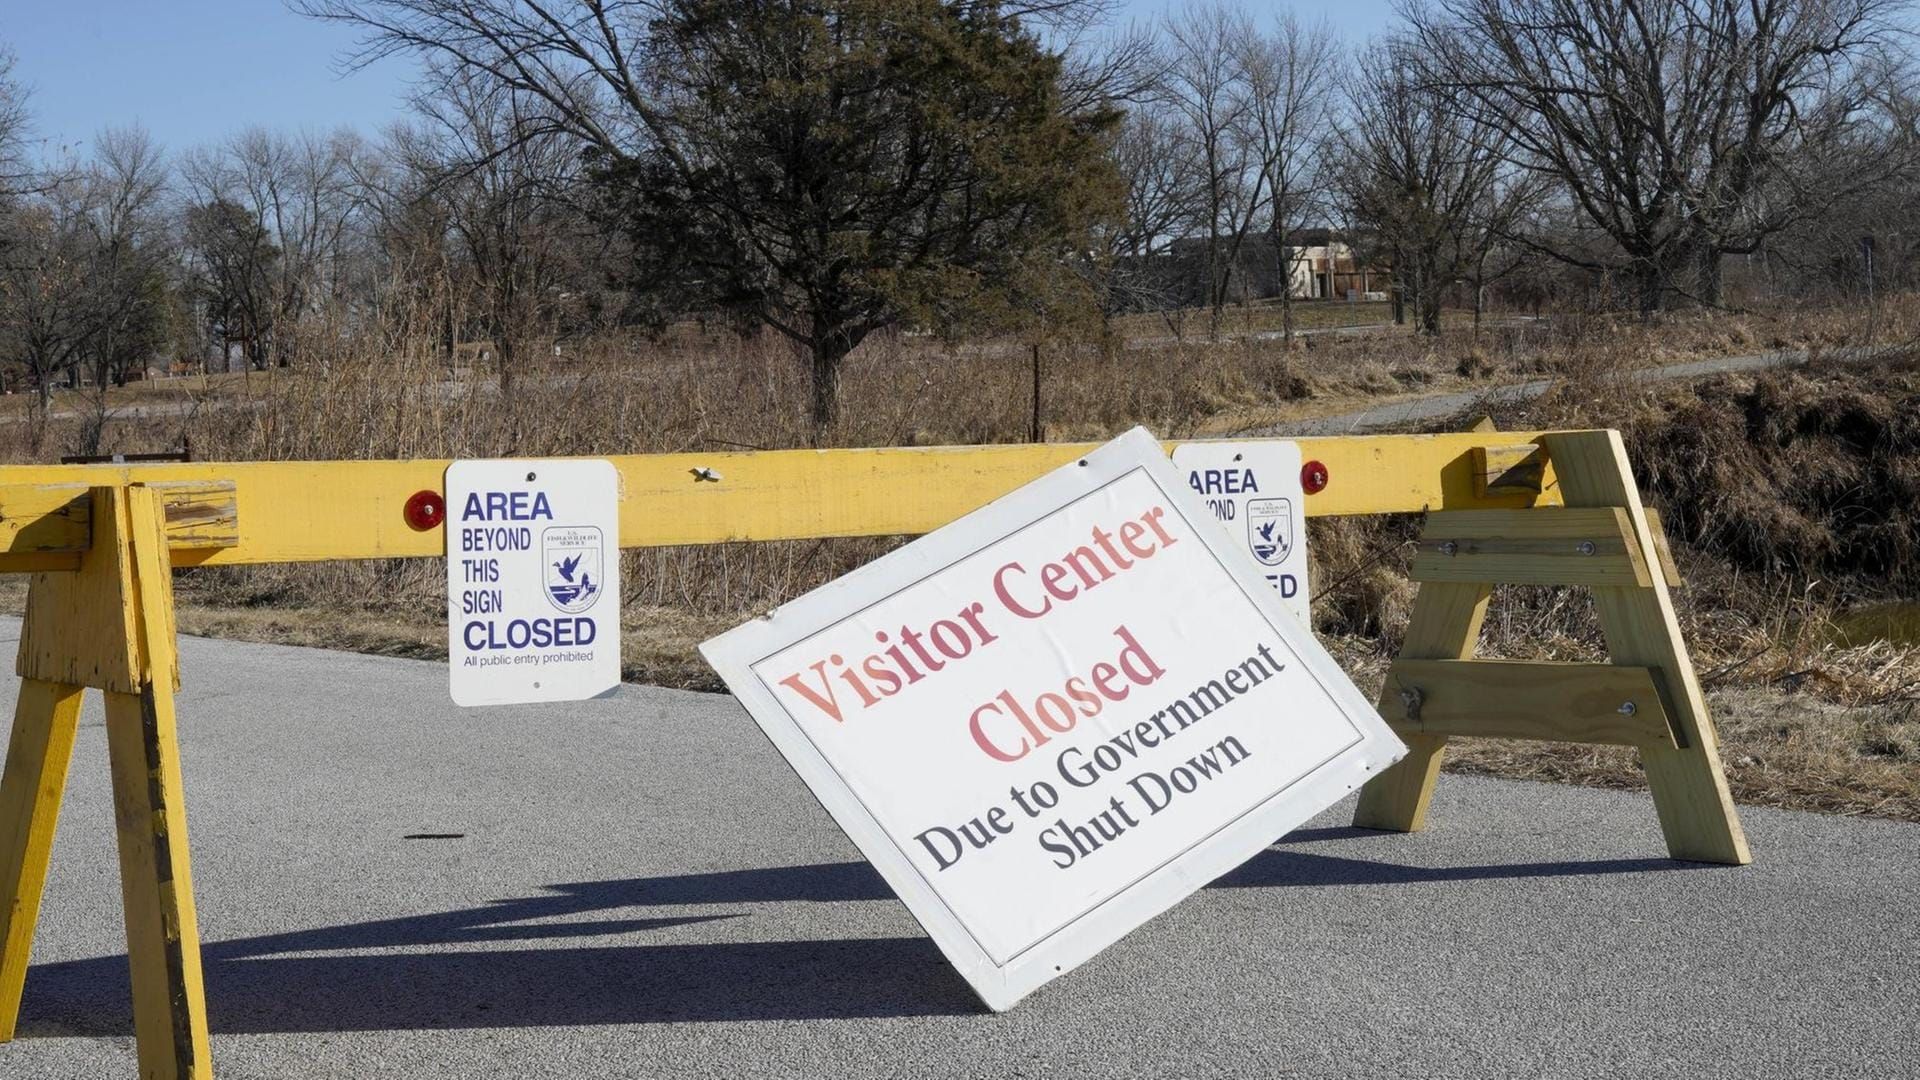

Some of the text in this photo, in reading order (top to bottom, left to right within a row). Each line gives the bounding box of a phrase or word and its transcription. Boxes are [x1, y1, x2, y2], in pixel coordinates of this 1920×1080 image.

[1188, 469, 1259, 495] AREA
[462, 491, 554, 522] AREA
[462, 527, 531, 552] BEYOND
[462, 558, 500, 583] THIS
[462, 589, 502, 615] SIGN
[779, 506, 1179, 724] Visitor Center
[463, 617, 597, 651] CLOSED
[464, 650, 594, 668] All public entry prohibited
[969, 625, 1167, 763] Closed
[912, 642, 1287, 873] Due to Government
[1038, 735, 1253, 870] Shut Down
